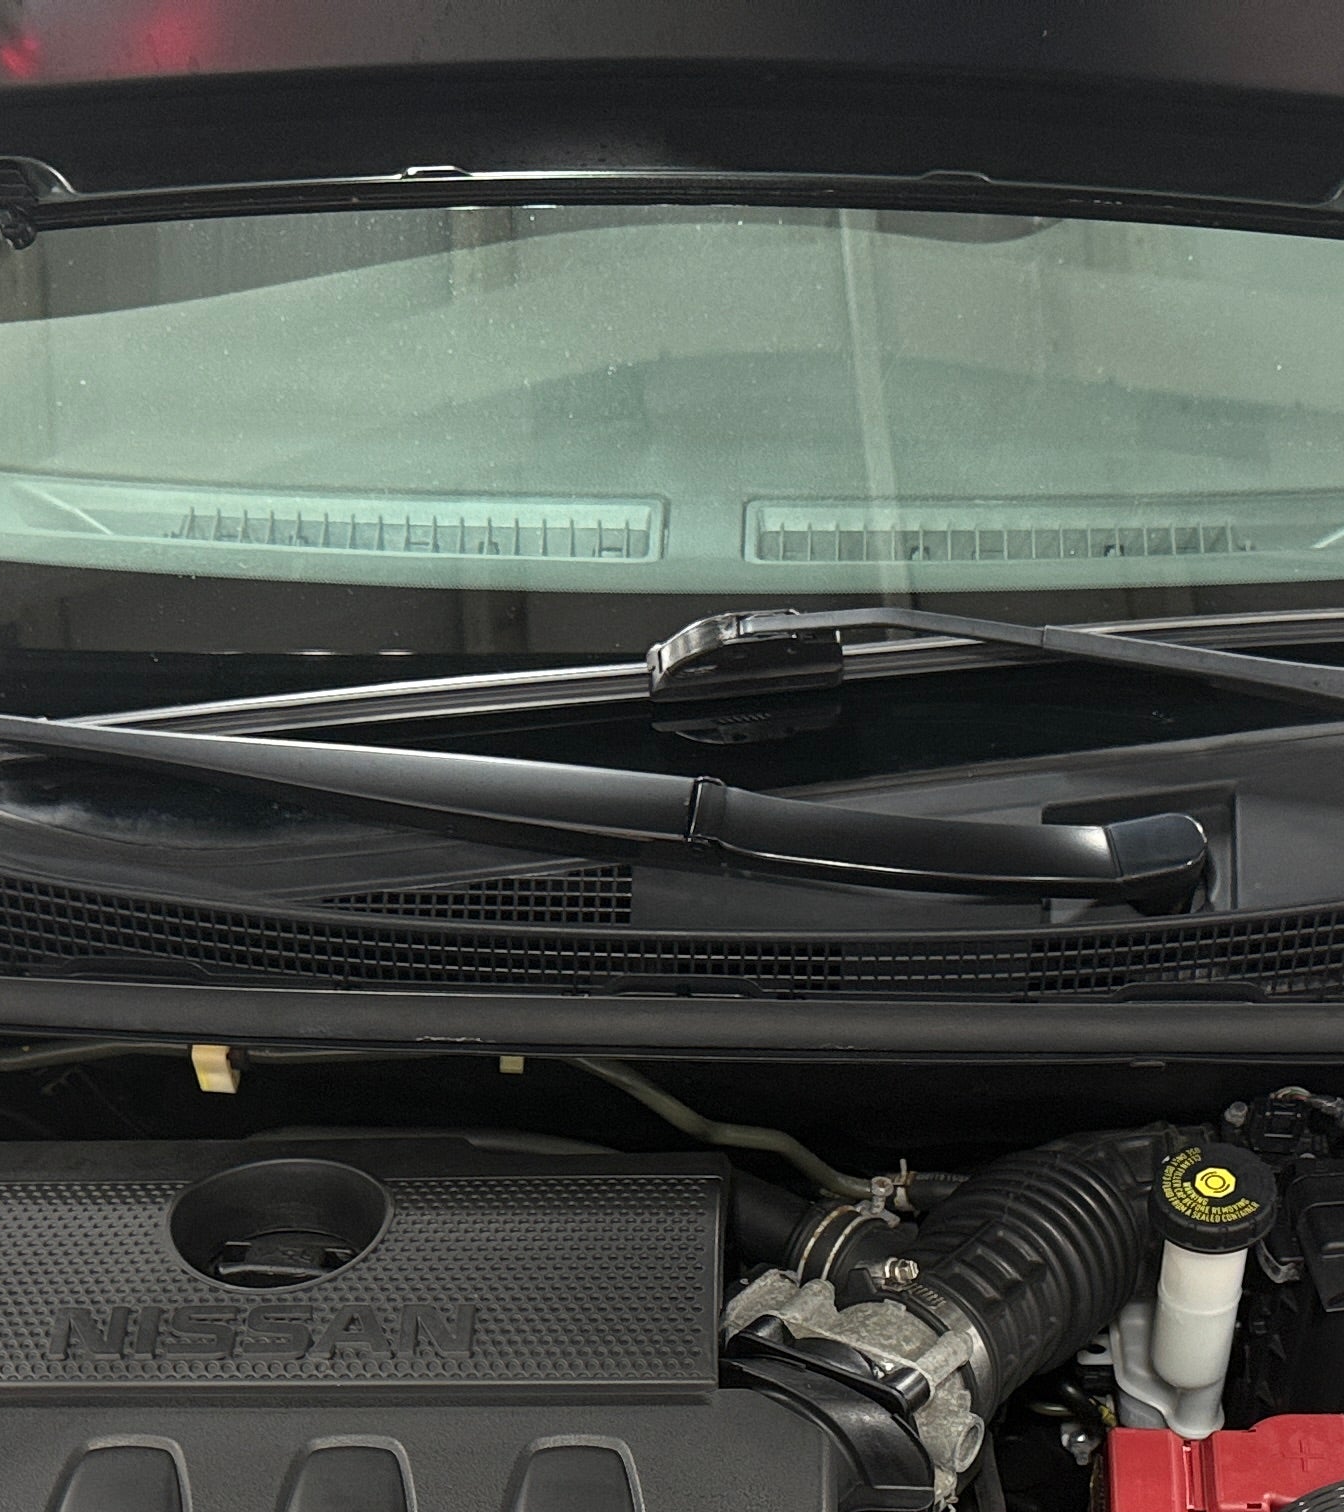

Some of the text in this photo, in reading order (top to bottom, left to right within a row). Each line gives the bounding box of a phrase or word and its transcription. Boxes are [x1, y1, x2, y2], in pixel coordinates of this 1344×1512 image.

[1191, 1210, 1221, 1223] SEALED
[1221, 1201, 1261, 1222] CONTAINER
[1211, 1198, 1250, 1215] REMOVING
[53, 1302, 475, 1363] NISSAN
